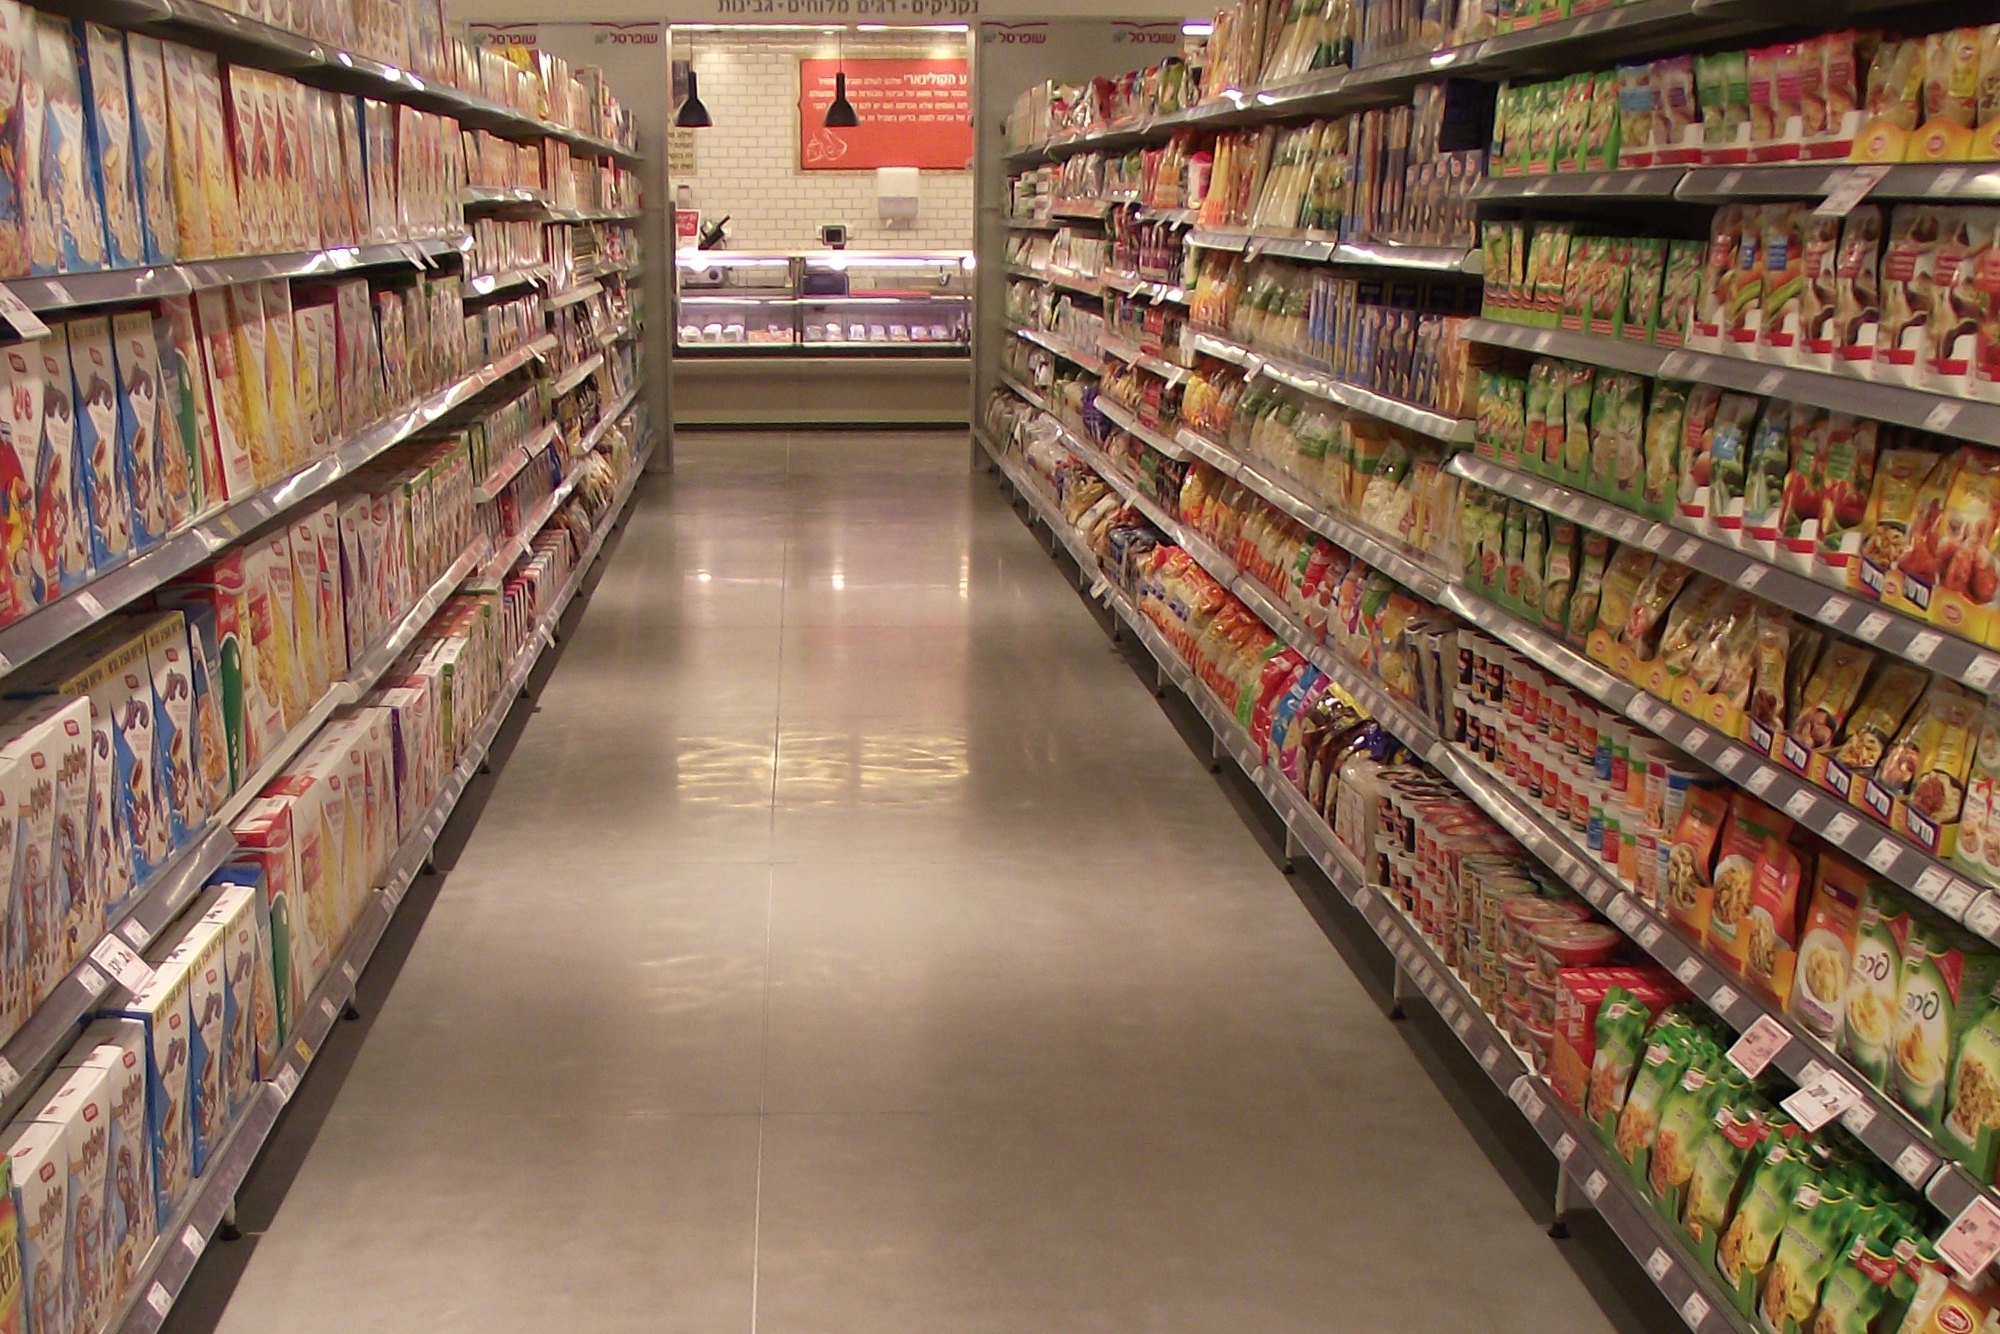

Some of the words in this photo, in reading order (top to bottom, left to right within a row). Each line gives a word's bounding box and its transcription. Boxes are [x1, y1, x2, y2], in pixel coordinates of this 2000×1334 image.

[718, 0, 773, 13] גבינות
[788, 0, 849, 13] מלוחים
[858, 0, 895, 13] דגים
[912, 0, 978, 16] נקניקים
[488, 33, 537, 45] שופרסל
[609, 32, 659, 45] שופרסל
[998, 32, 1047, 44] שופרסל
[1128, 32, 1177, 44] שופרסל
[903, 72, 956, 86] הקולינארי
[1859, 952, 1890, 981] פירה
[1905, 991, 1940, 1020] פירה
